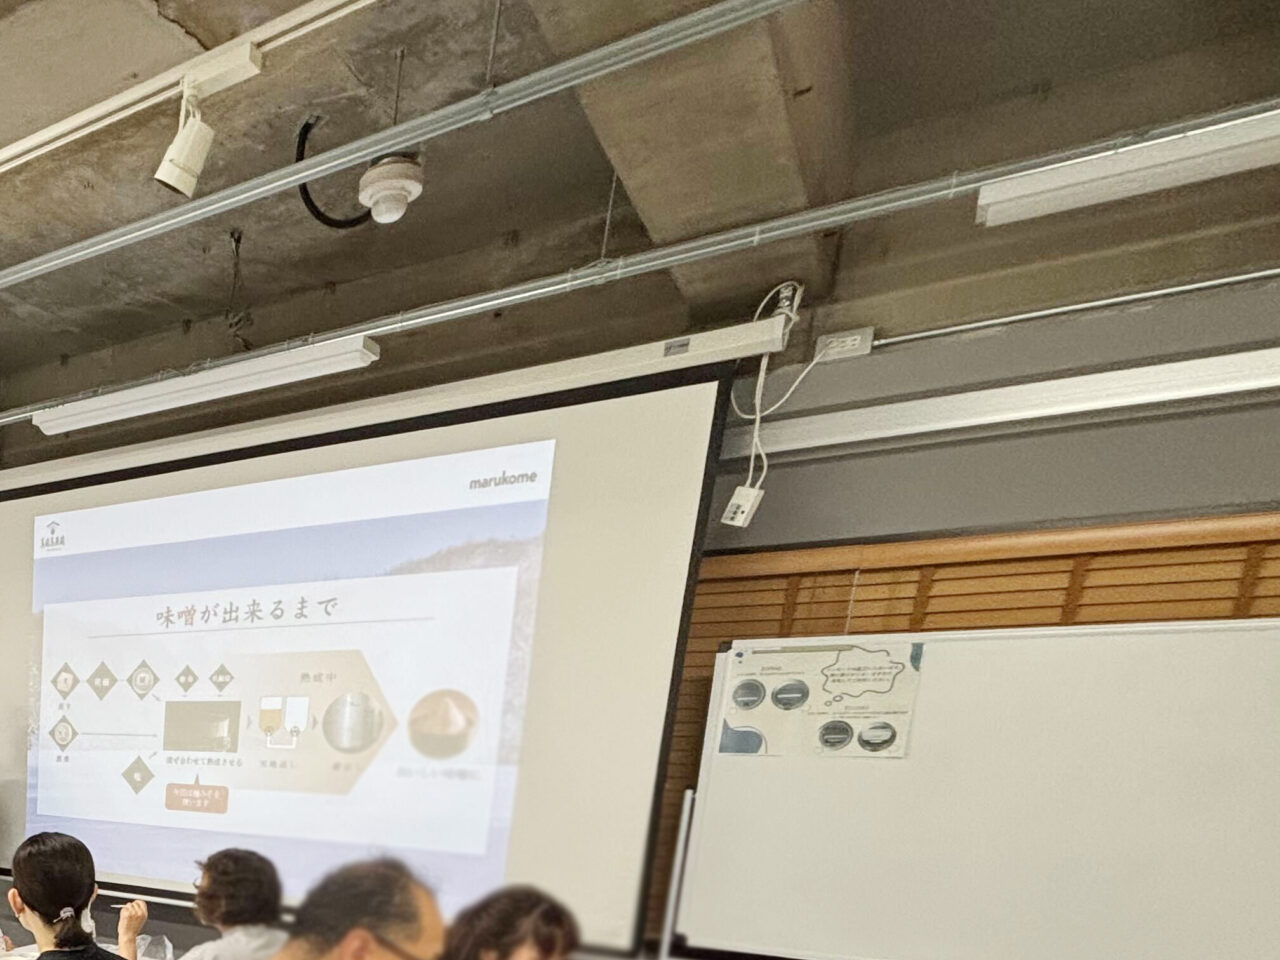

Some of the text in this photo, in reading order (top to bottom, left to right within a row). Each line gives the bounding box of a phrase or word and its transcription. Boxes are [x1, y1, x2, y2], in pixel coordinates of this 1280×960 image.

[469, 470, 538, 490] marukome
[156, 597, 339, 628] 味噌が出来るまで
